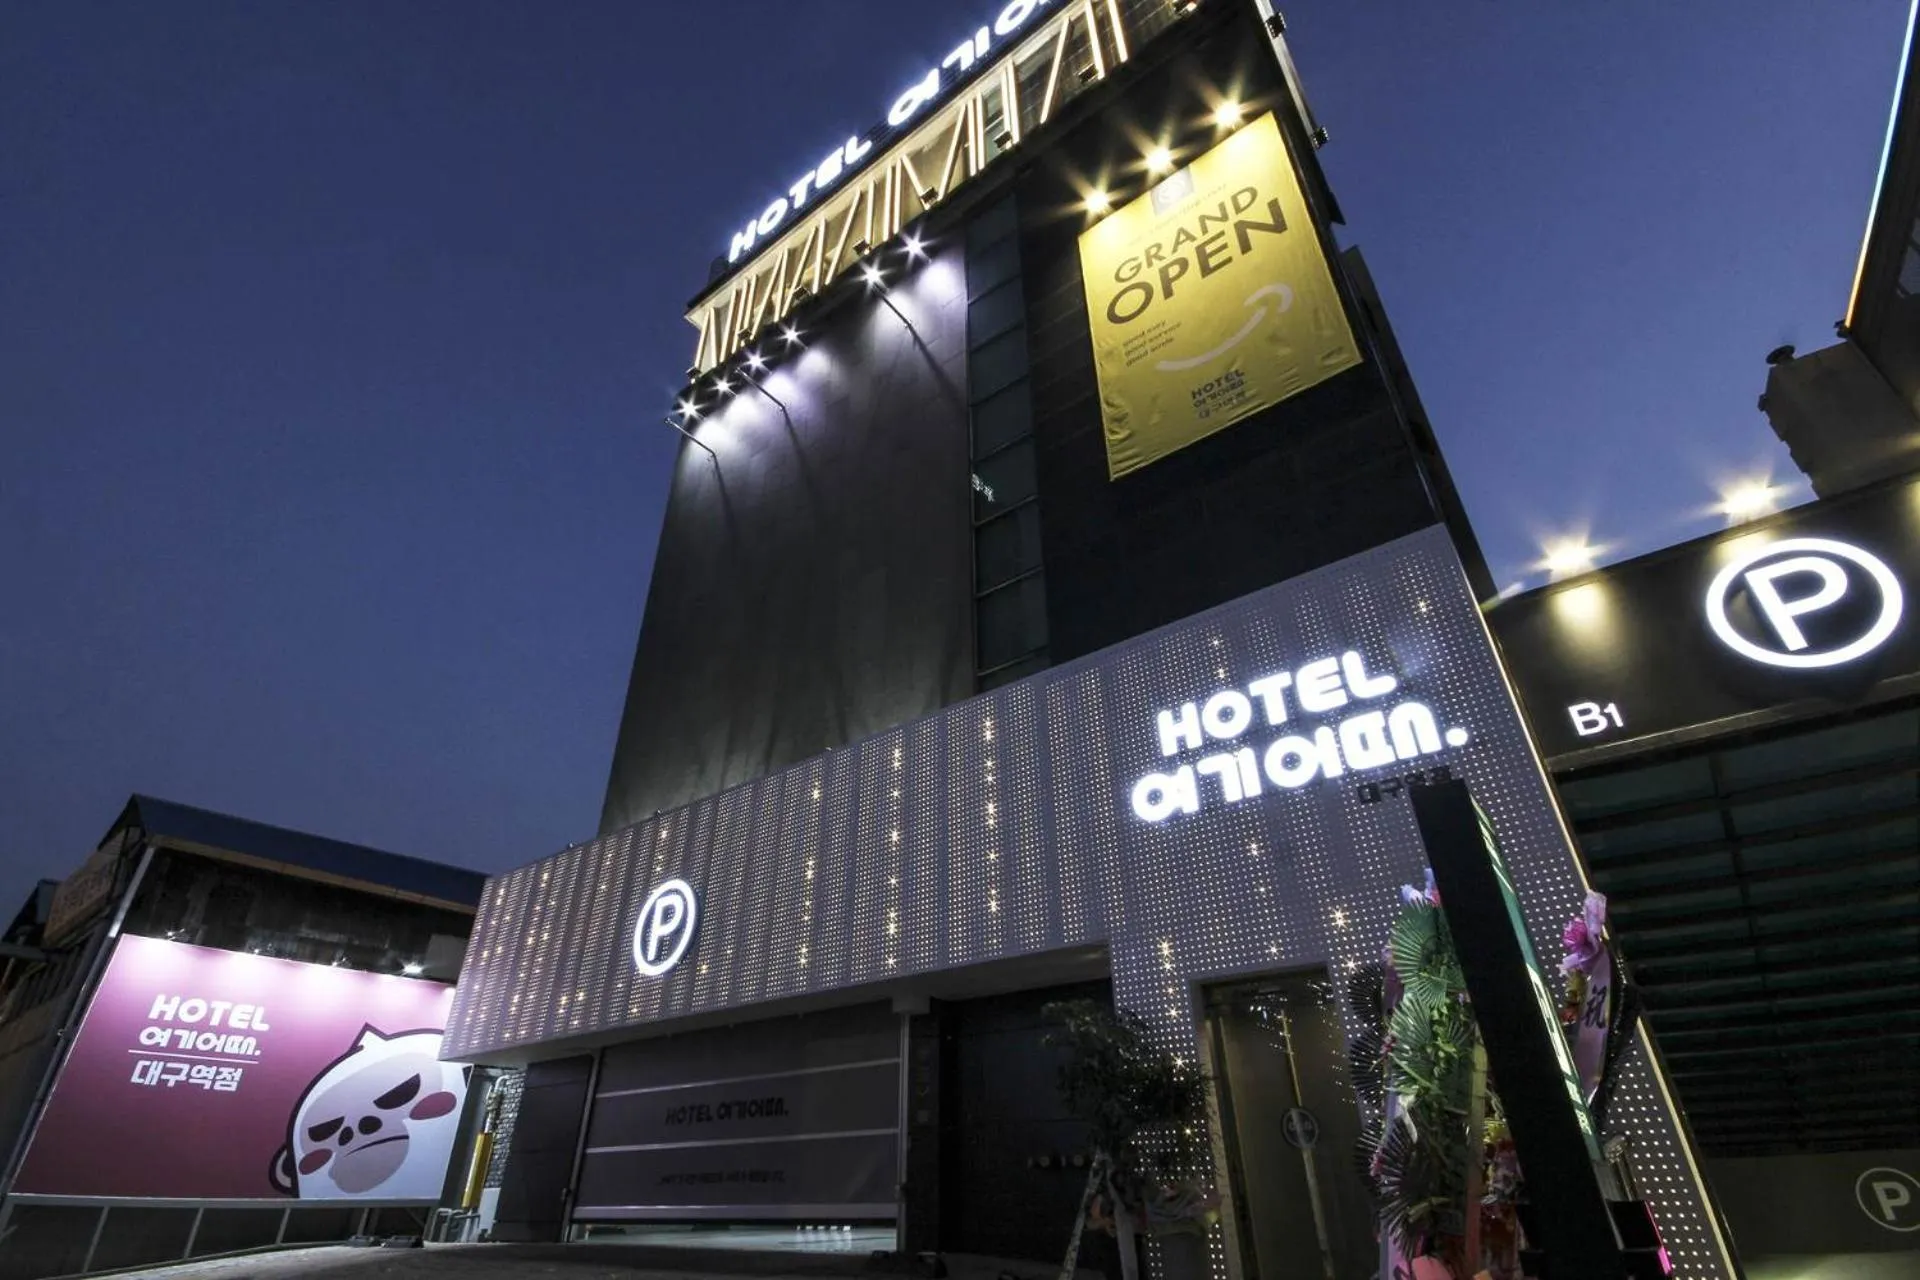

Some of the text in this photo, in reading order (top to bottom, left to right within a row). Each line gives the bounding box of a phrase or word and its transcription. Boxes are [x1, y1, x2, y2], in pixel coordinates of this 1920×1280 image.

[728, 136, 872, 263] HOTEL
[1106, 197, 1288, 325] OPEN
[1114, 186, 1258, 283] GRAND
[1191, 369, 1246, 400] HOTEL
[1745, 556, 1848, 652] P
[1156, 650, 1397, 757] HOTEL
[1568, 701, 1624, 737] B1
[648, 894, 684, 961] P
[148, 994, 270, 1032] HOTEL
[130, 1060, 244, 1092] 대구역점
[665, 1104, 713, 1127] HOTEL
[1872, 1181, 1911, 1220] P
